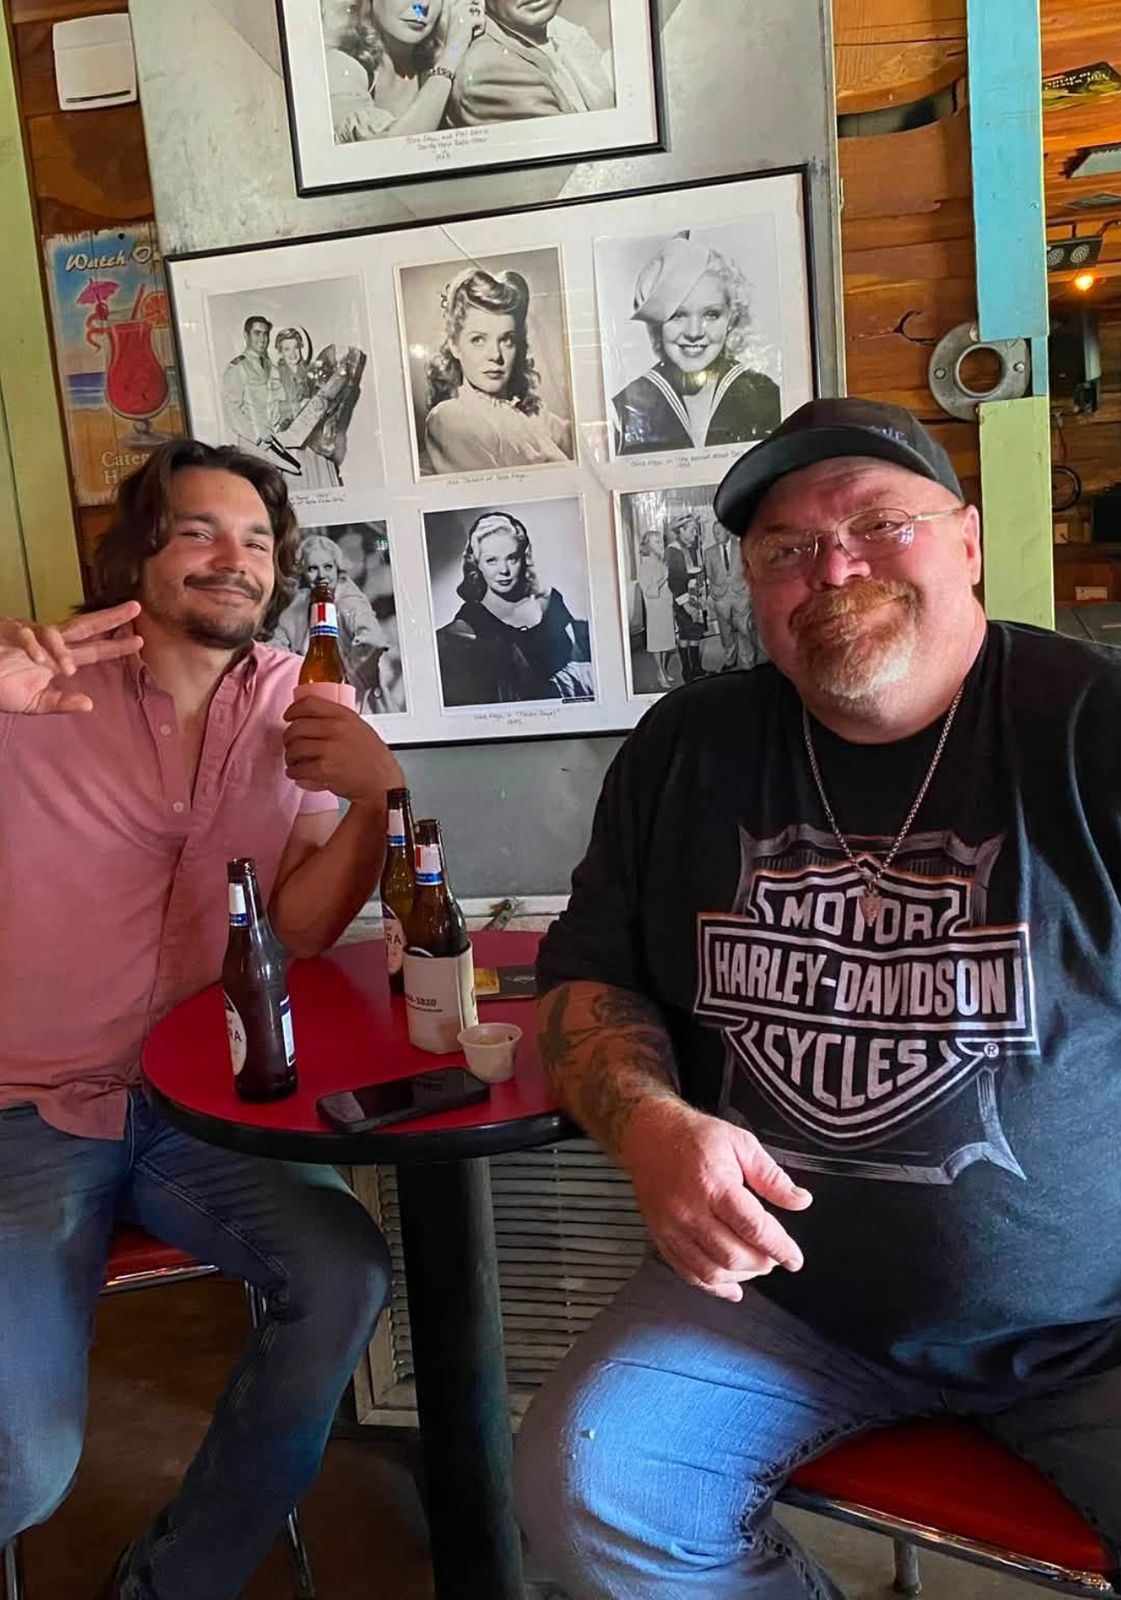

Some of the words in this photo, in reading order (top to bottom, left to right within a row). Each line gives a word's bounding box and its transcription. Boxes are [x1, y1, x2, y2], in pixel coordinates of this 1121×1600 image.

[781, 888, 932, 945] MOTOR
[714, 940, 1007, 1017] HARLEY-DAVIDSON
[763, 1024, 927, 1110] CYCLES
